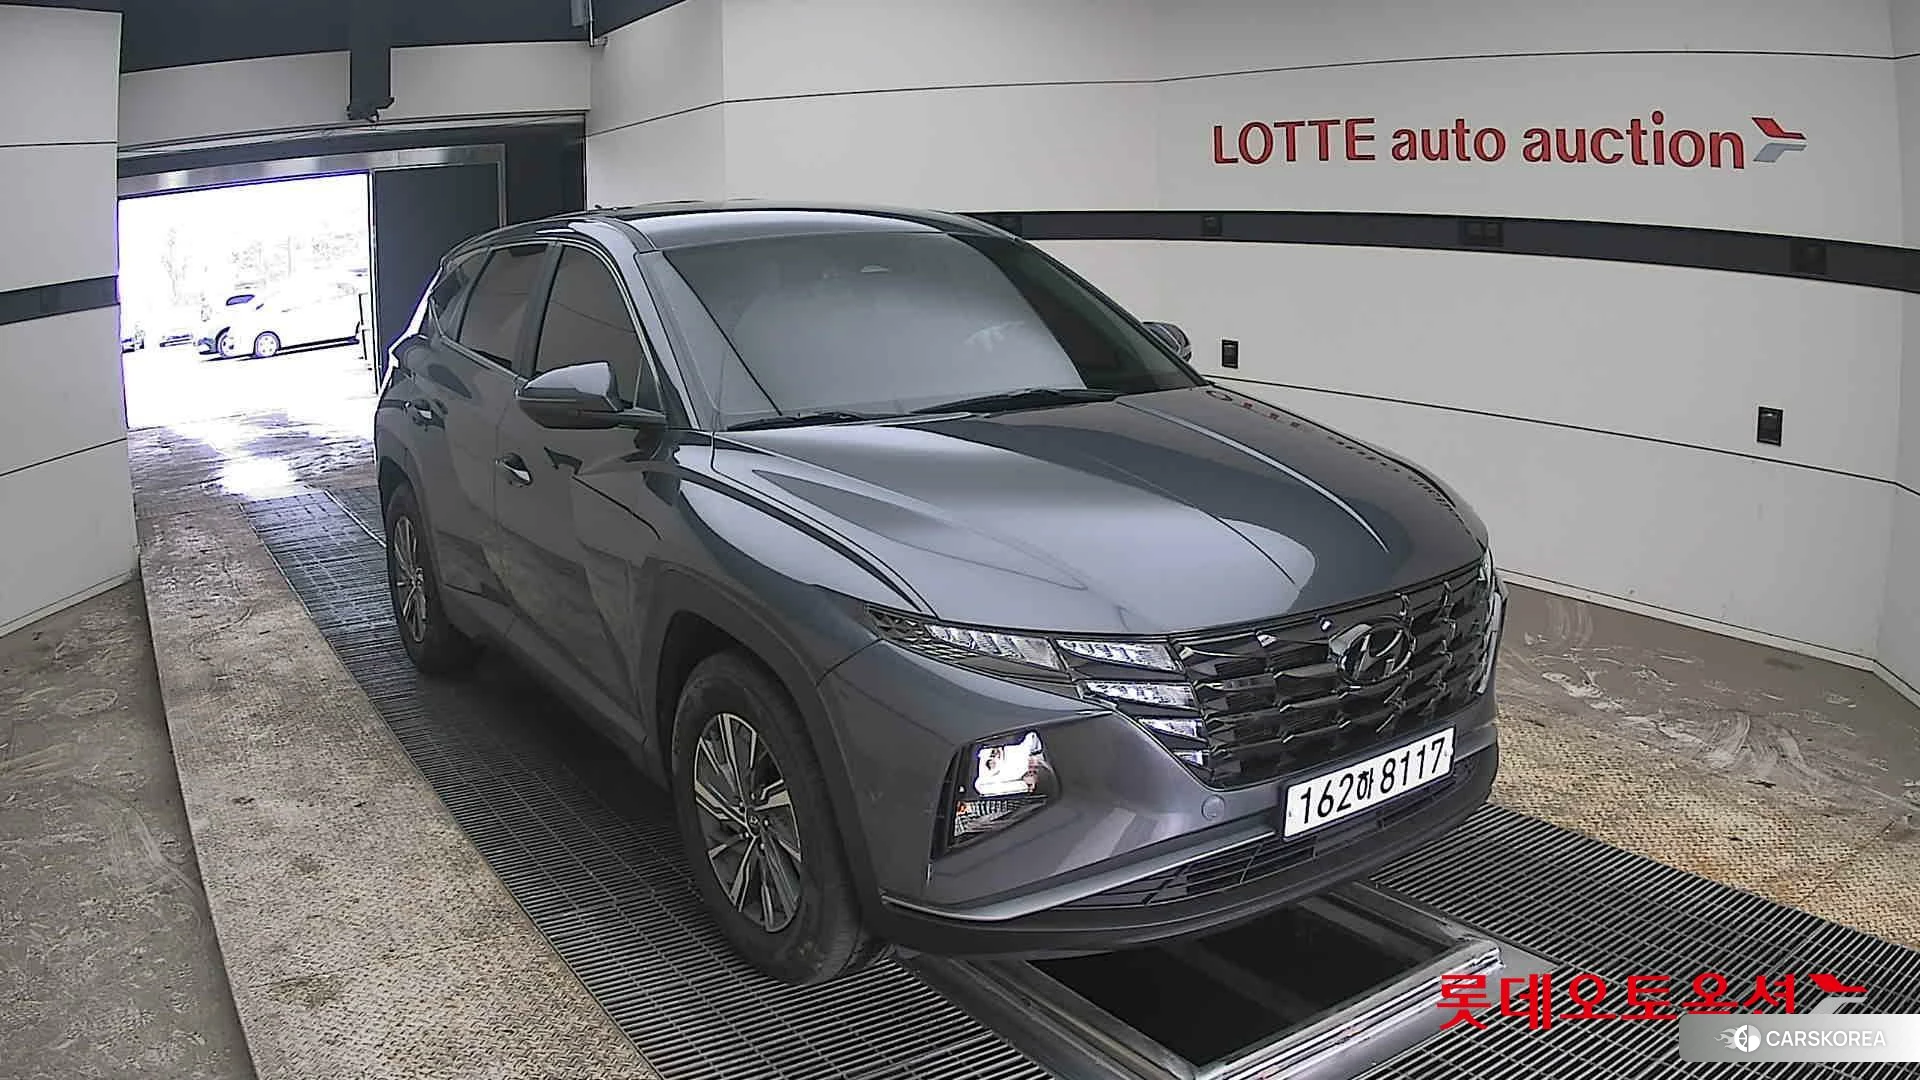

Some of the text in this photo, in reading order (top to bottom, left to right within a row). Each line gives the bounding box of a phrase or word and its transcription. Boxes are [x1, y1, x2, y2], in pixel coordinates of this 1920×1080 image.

[1213, 110, 1745, 169] LOTTE auto auction
